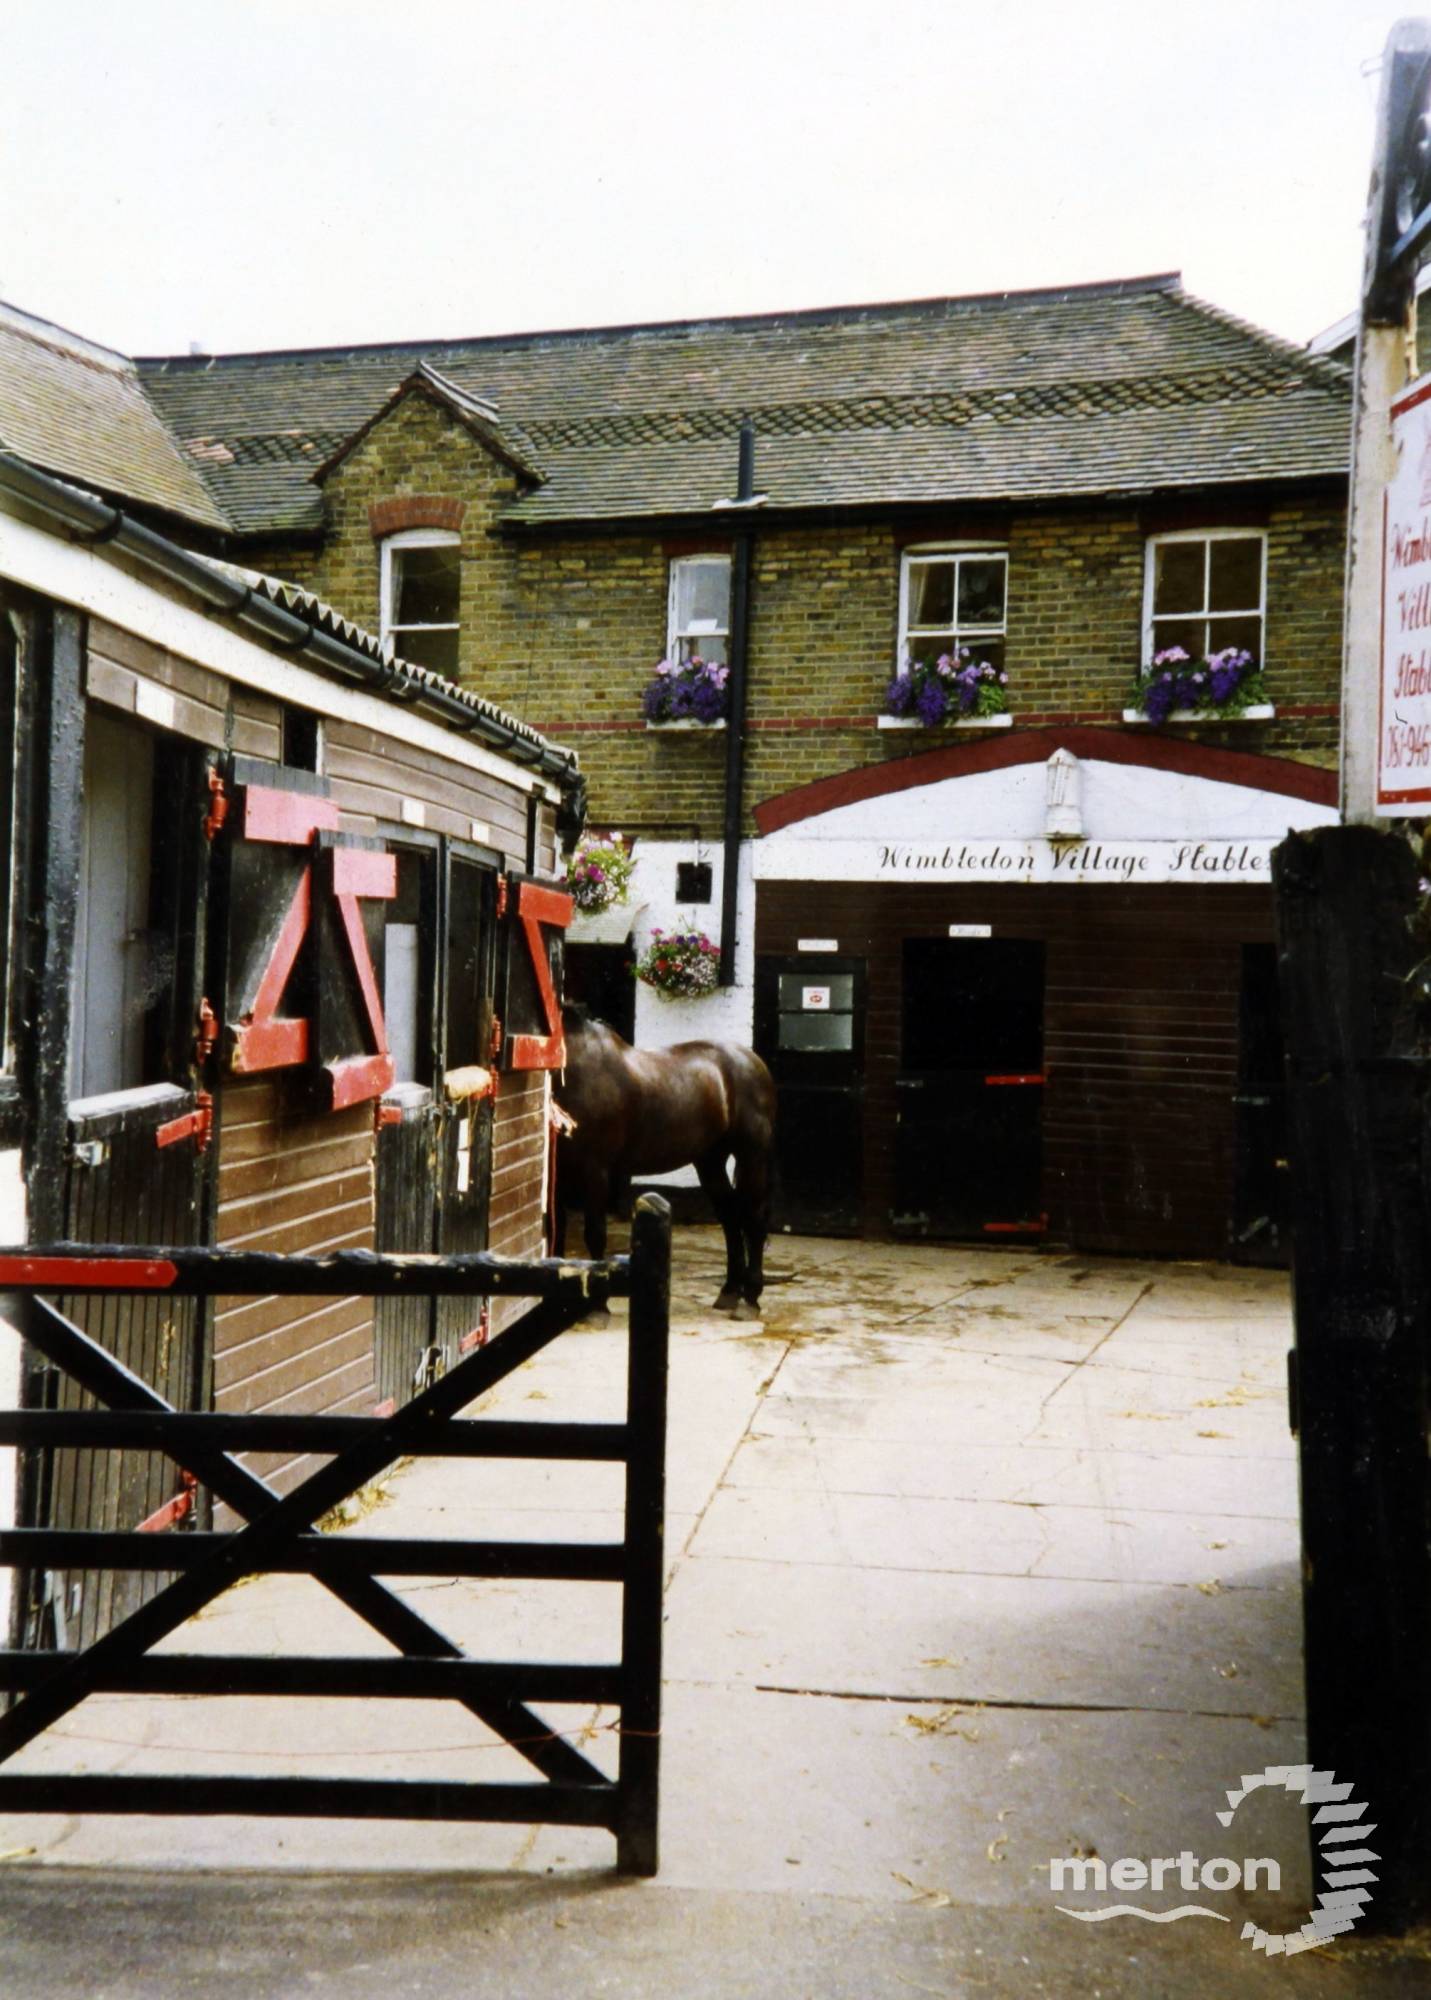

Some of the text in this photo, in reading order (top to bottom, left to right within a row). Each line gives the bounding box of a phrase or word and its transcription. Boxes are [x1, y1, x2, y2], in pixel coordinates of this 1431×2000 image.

[1398, 582, 1431, 632] Vill
[878, 845, 1035, 871] Wimbledon
[1052, 846, 1148, 880] Village
